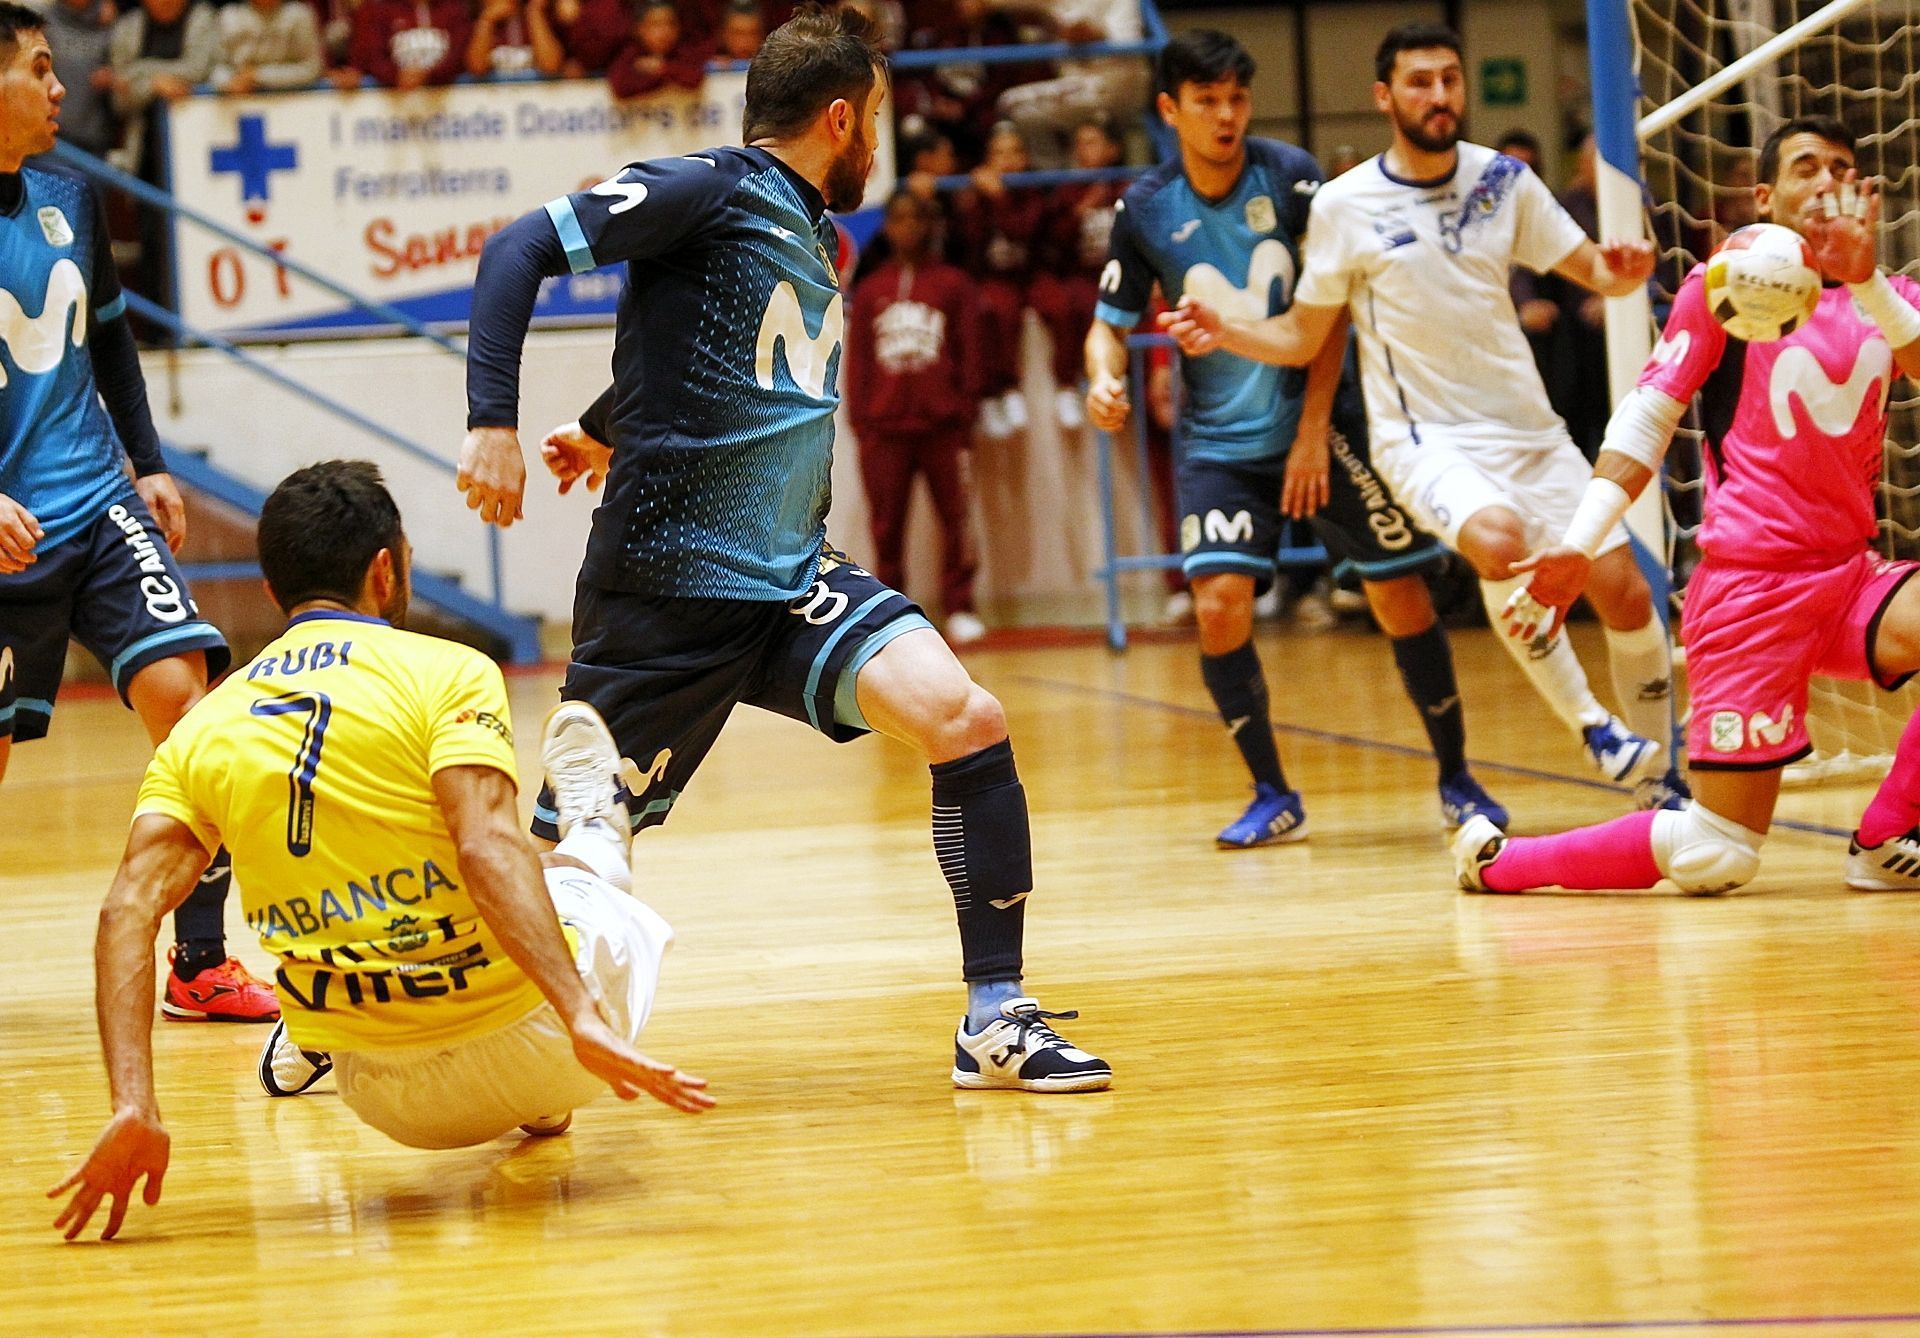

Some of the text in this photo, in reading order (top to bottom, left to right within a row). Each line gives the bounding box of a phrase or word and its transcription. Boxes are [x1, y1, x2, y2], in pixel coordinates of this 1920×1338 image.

[247, 641, 353, 682] RUBI
[250, 690, 332, 858] 7
[265, 859, 459, 939] ABANCA
